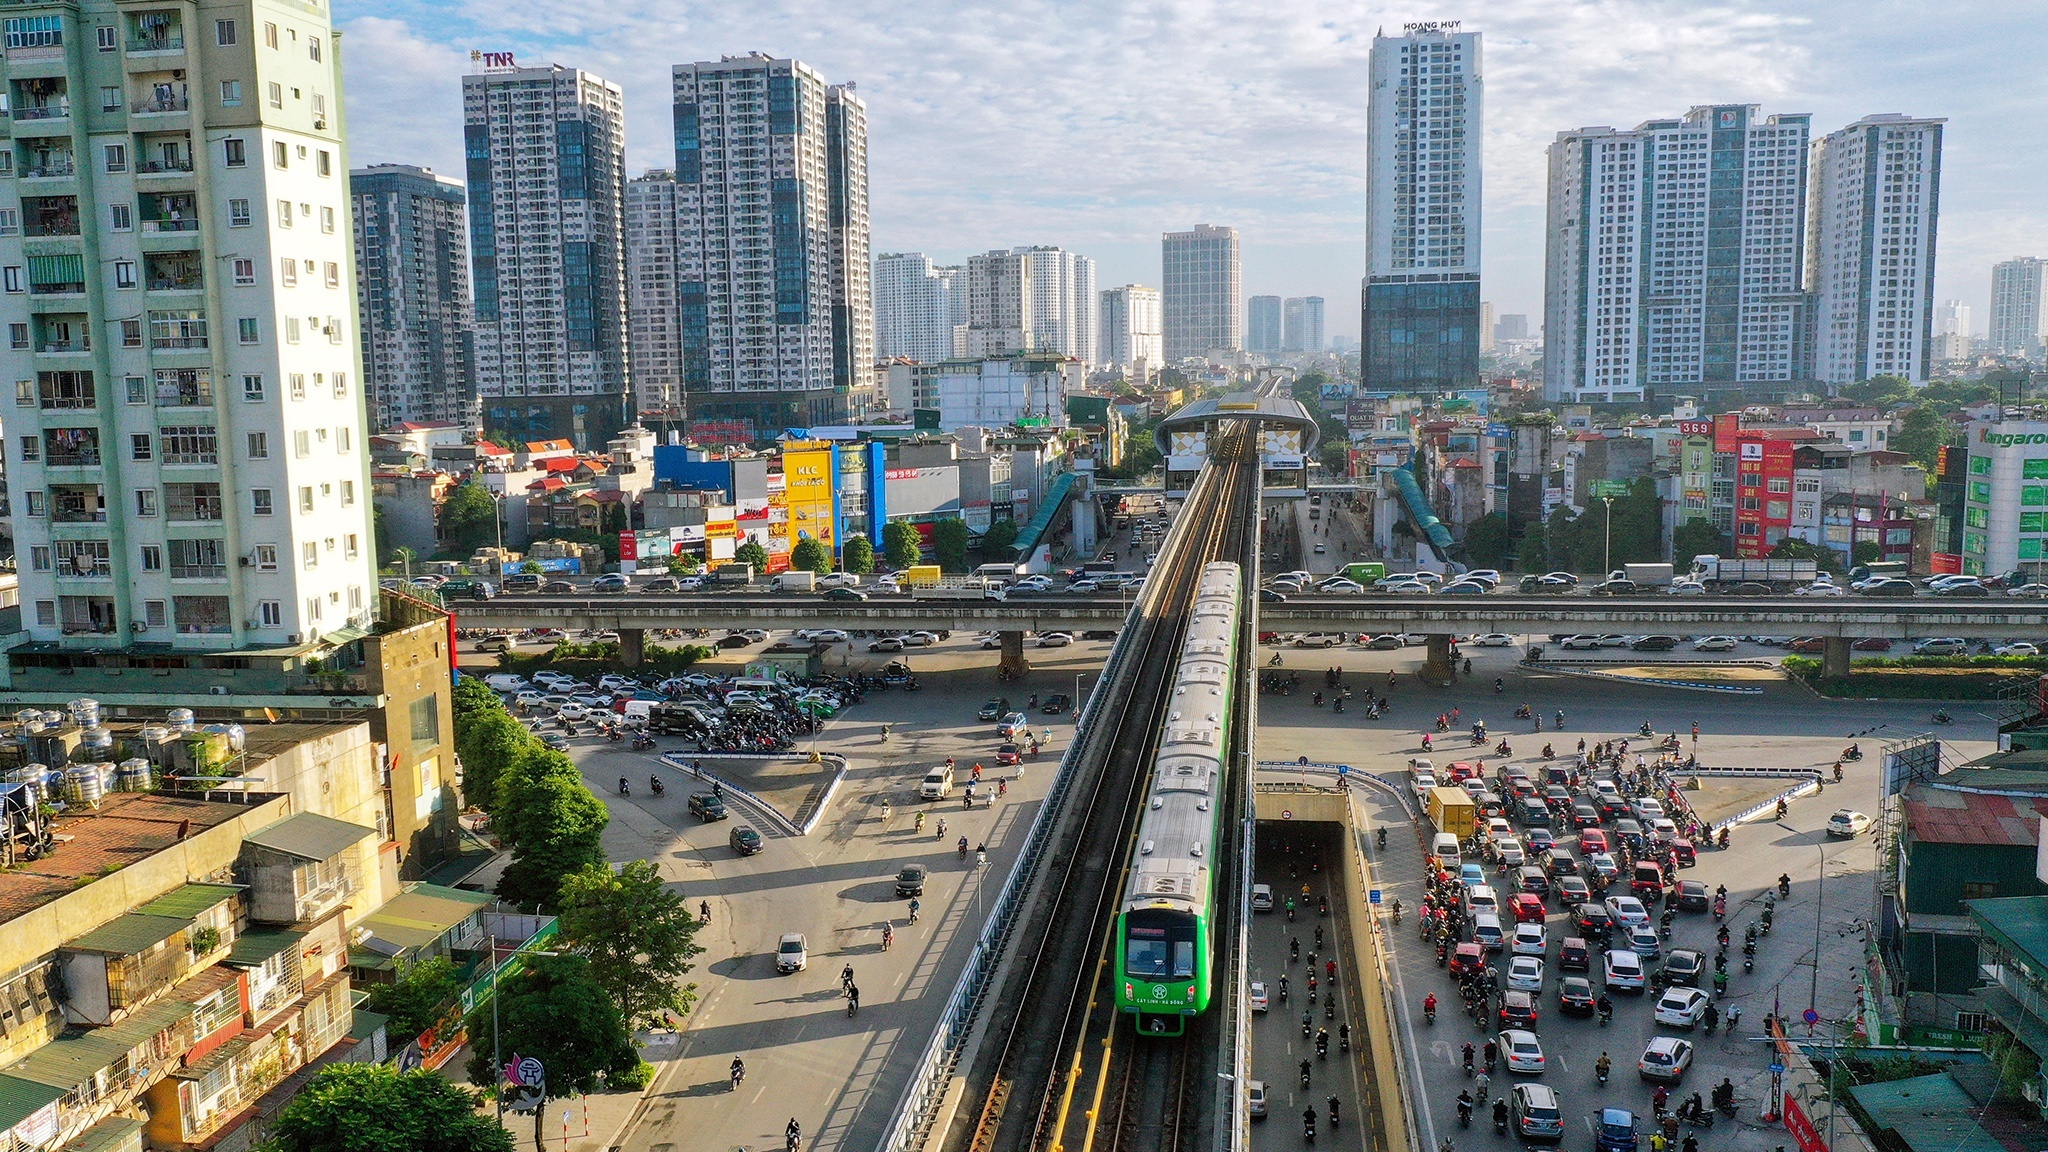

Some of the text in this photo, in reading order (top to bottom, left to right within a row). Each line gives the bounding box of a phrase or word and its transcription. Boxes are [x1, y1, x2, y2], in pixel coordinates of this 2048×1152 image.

[1404, 20, 1461, 30] HOANG HUY
[483, 52, 515, 67] TNR
[1683, 423, 1708, 433] 369
[798, 466, 818, 475] KLC
